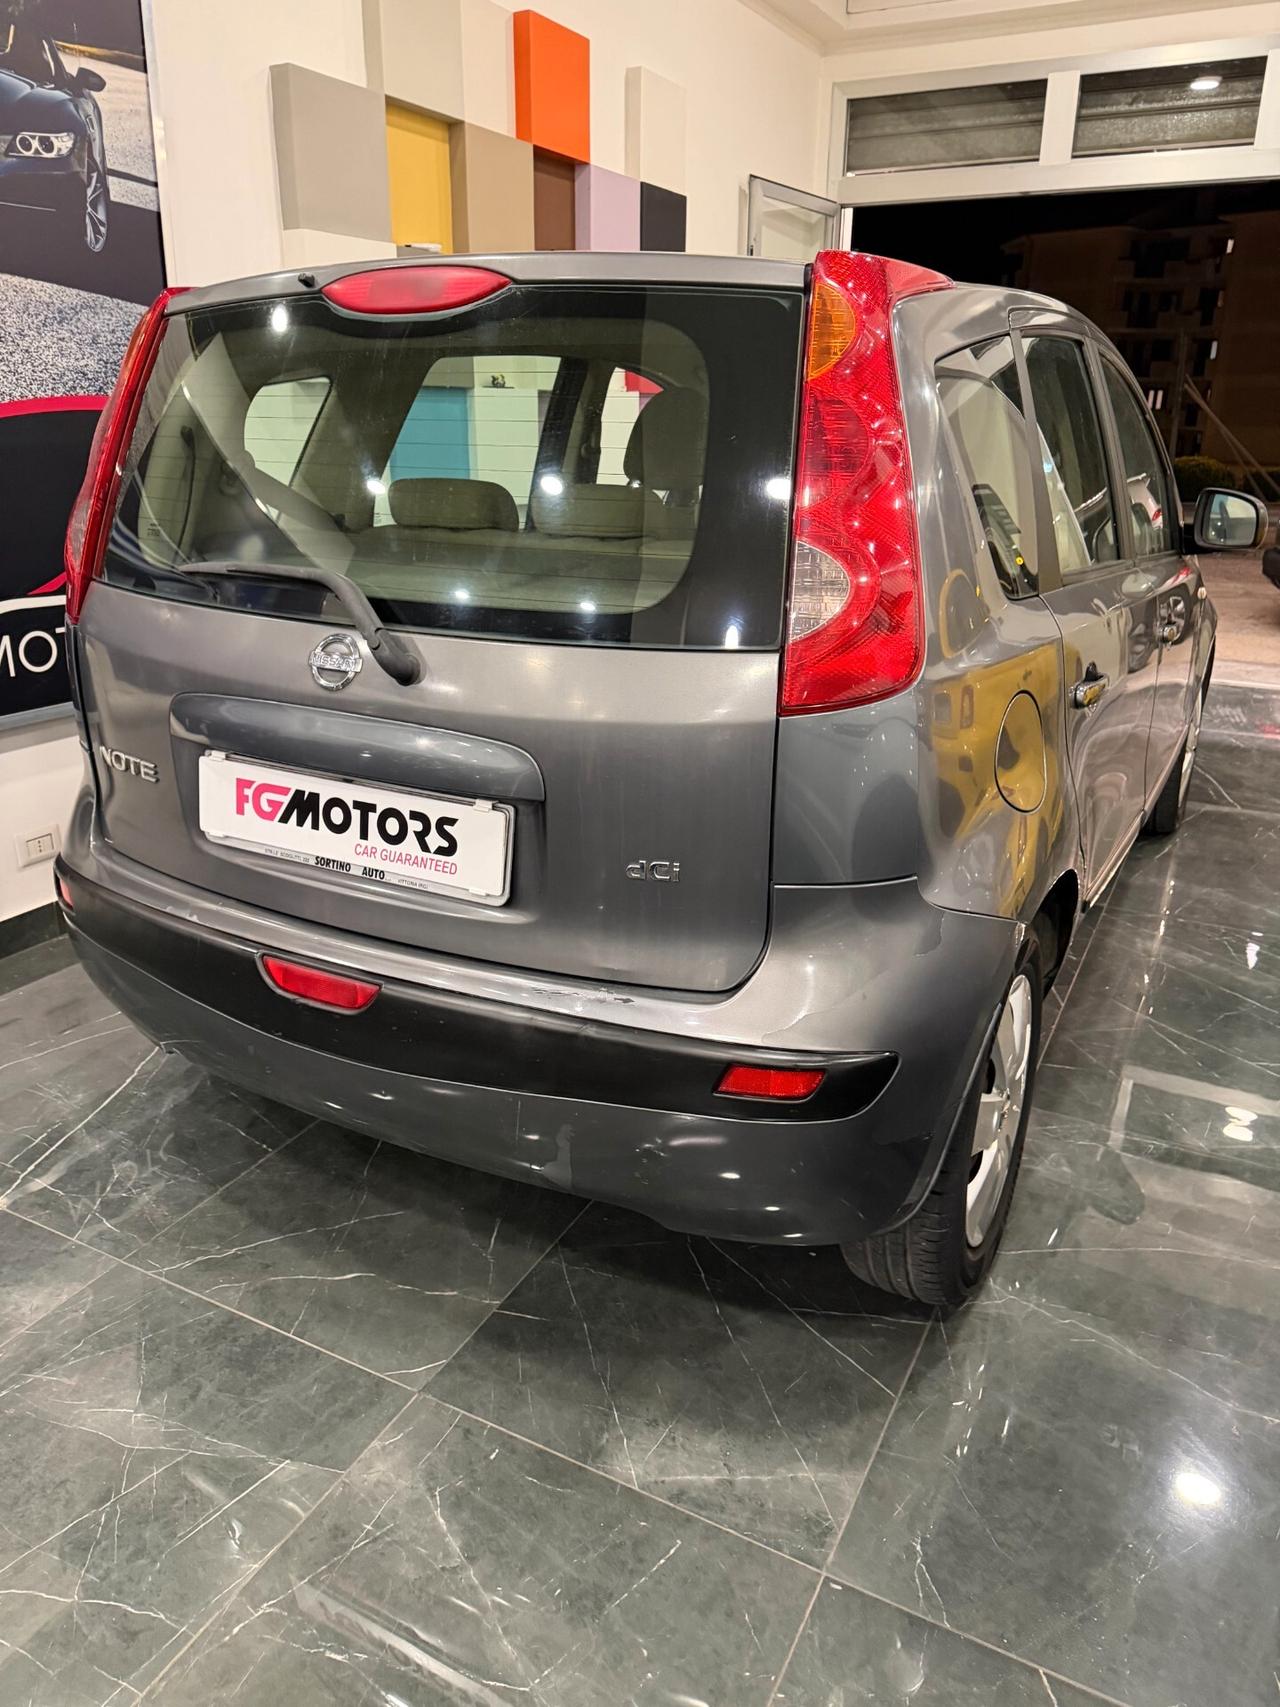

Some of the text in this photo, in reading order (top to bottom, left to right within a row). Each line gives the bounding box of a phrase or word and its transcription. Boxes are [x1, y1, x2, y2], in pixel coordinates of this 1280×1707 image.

[99, 745, 159, 783] NOTE
[314, 856, 351, 872] SORTINO
[361, 866, 385, 880] AUTO
[354, 843, 458, 875] CAR GUARANTEED
[625, 860, 680, 881] dCi
